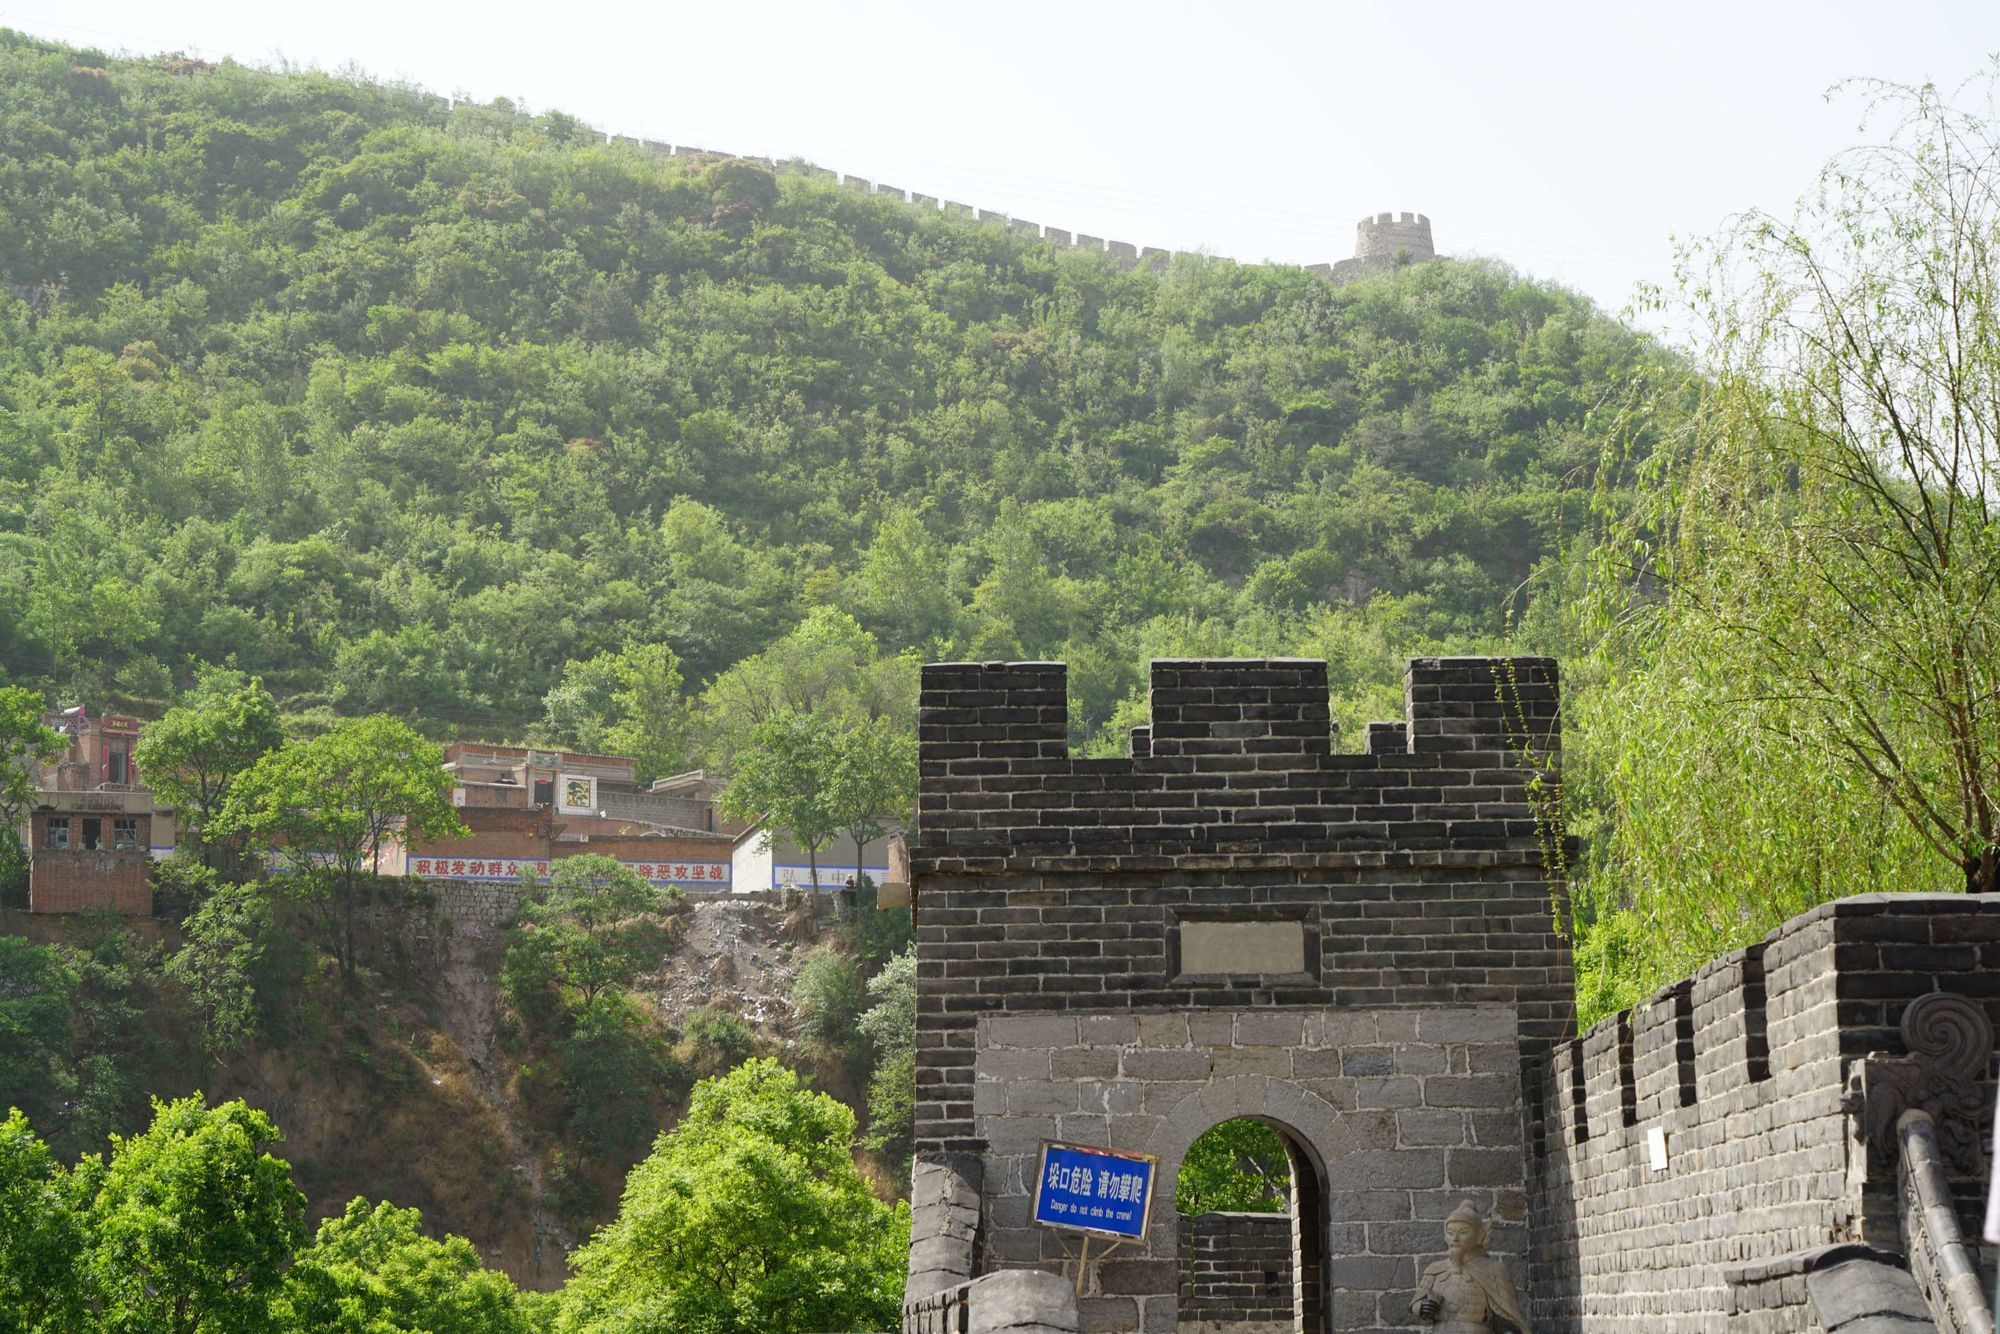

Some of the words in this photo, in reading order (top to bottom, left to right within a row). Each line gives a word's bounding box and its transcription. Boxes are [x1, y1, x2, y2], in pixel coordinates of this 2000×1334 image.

[415, 860, 518, 876] 积极发动群众
[1048, 1162, 1093, 1197] 垛口危险
[1097, 1169, 1143, 1204] 请勿攀爬
[1050, 1199, 1068, 1214] Danger
[1070, 1202, 1077, 1214] do
[1079, 1205, 1088, 1216] not
[1090, 1206, 1104, 1218] climb
[1105, 1208, 1114, 1219] the
